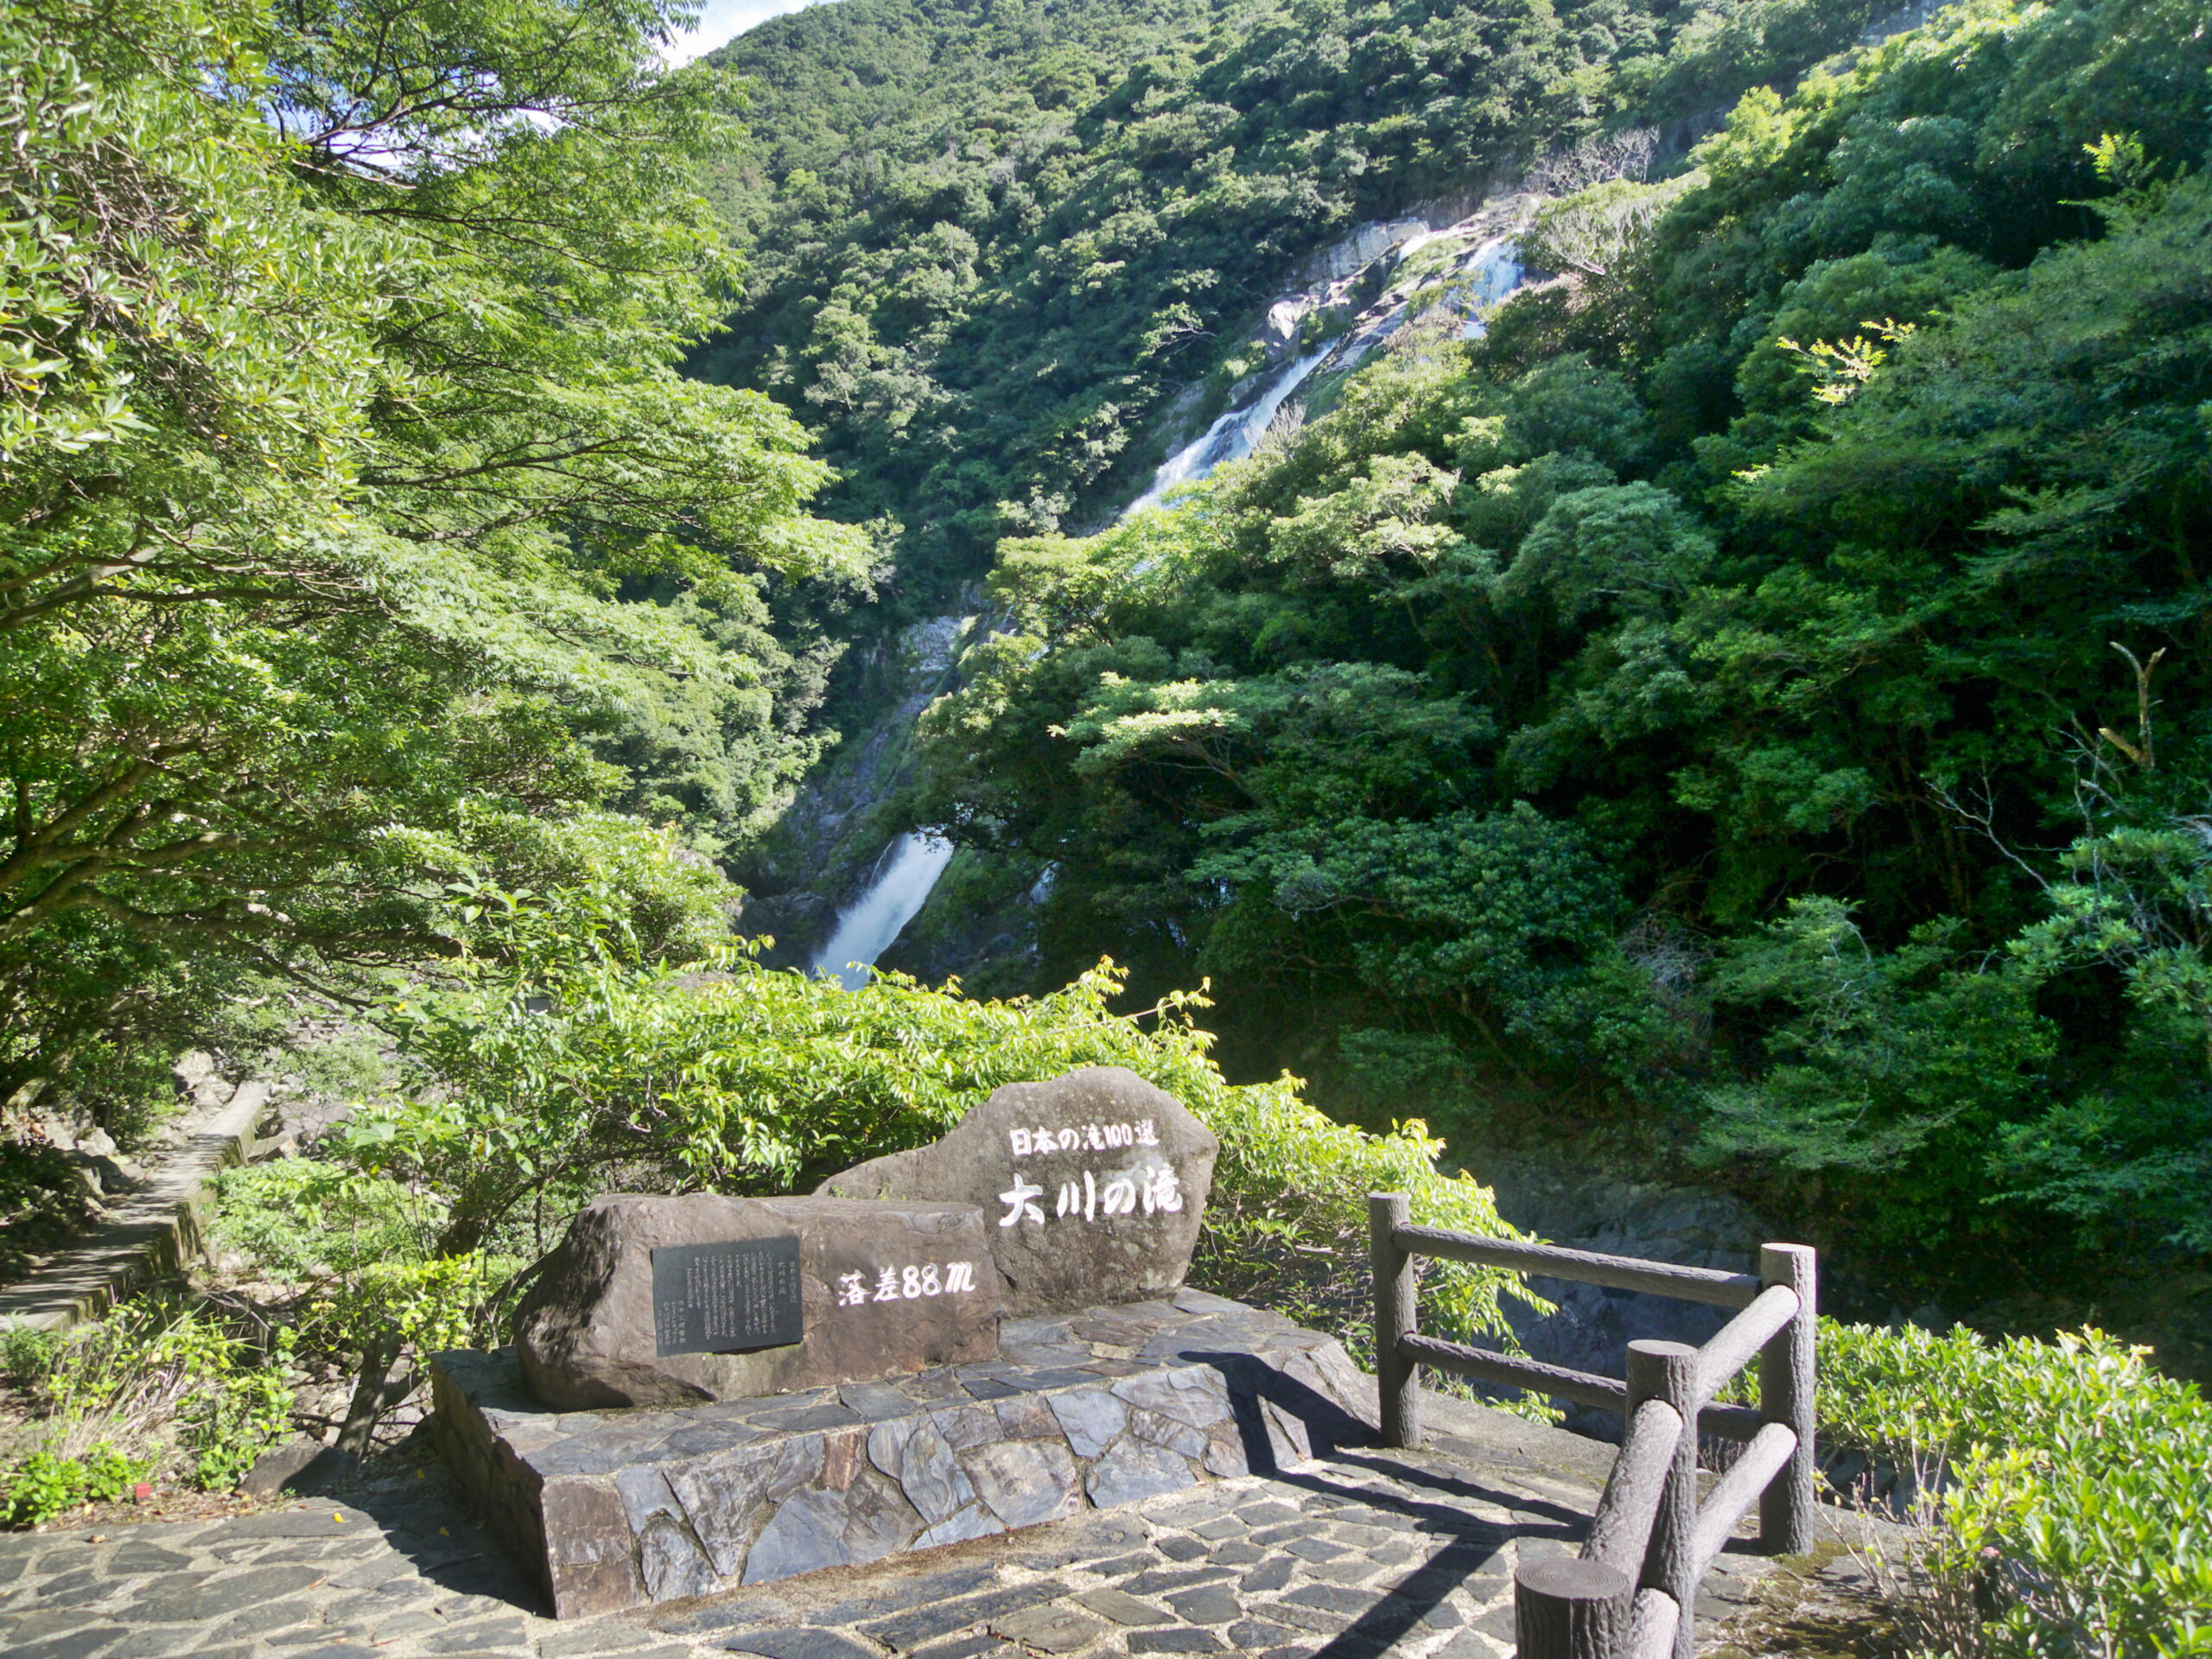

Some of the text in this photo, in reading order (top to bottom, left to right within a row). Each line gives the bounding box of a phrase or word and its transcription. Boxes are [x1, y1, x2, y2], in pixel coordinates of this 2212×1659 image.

[1010, 1119, 1160, 1156] 日本の滝100選
[999, 1164, 1183, 1227] 大川の滝
